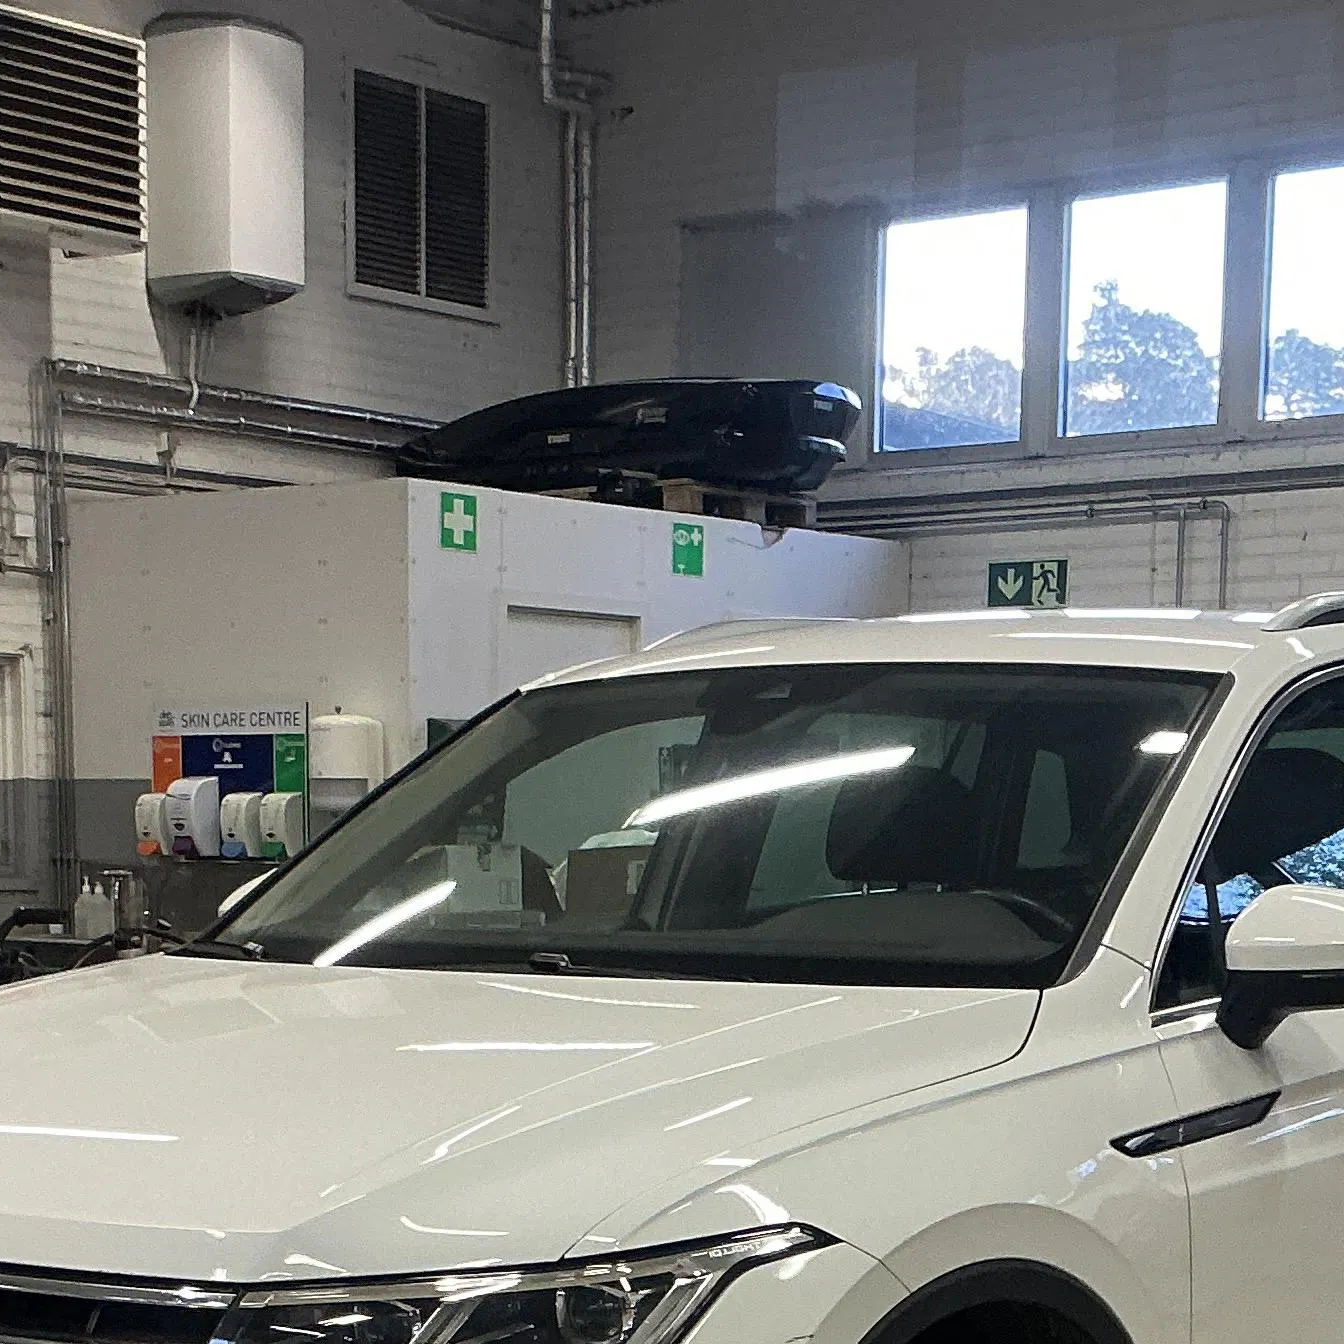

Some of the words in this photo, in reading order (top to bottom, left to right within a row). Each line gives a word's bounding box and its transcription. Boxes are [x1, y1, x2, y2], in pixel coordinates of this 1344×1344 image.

[181, 711, 210, 728] SKIN
[214, 711, 246, 728] CARE
[250, 711, 301, 727] CENTRE
